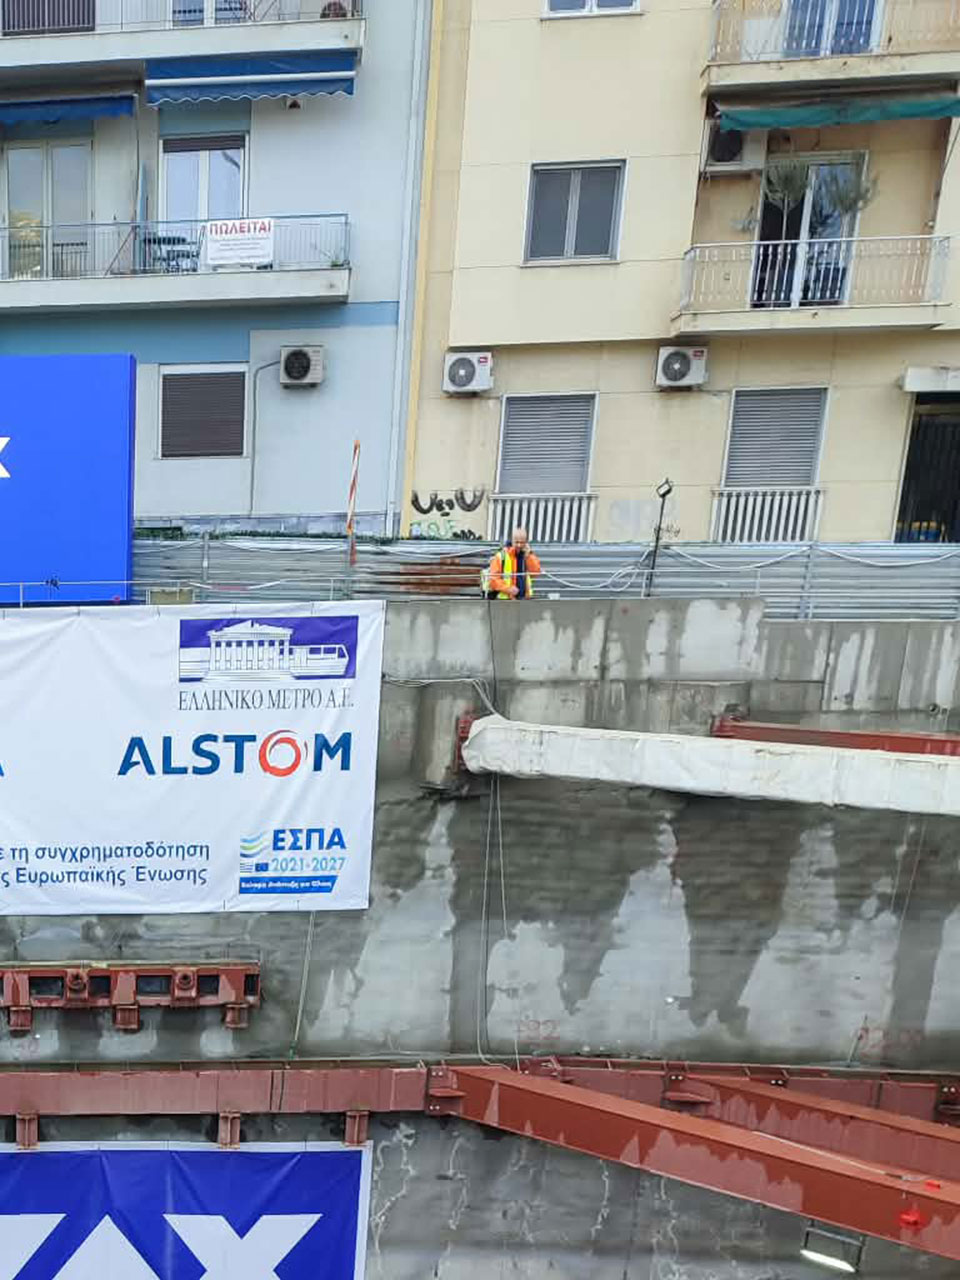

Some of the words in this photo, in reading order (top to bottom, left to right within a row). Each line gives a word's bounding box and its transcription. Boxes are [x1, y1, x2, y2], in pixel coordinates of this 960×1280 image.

[209, 220, 271, 236] ΠΩΛΕΙΤΑΙ
[178, 687, 264, 712] ΕΛΛΗΝΙΚΟ
[266, 687, 323, 710] ΜΕΤΡΟ
[116, 729, 353, 778] ALSTOM
[271, 827, 347, 851] ΕΣΠΑ
[10, 846, 29, 864] τη
[35, 841, 210, 864] συγχρηματοδότηση
[271, 857, 346, 872] 2021-2027
[15, 865, 126, 888] Ευρωπαϊκής
[131, 864, 208, 886] Ένωσης
